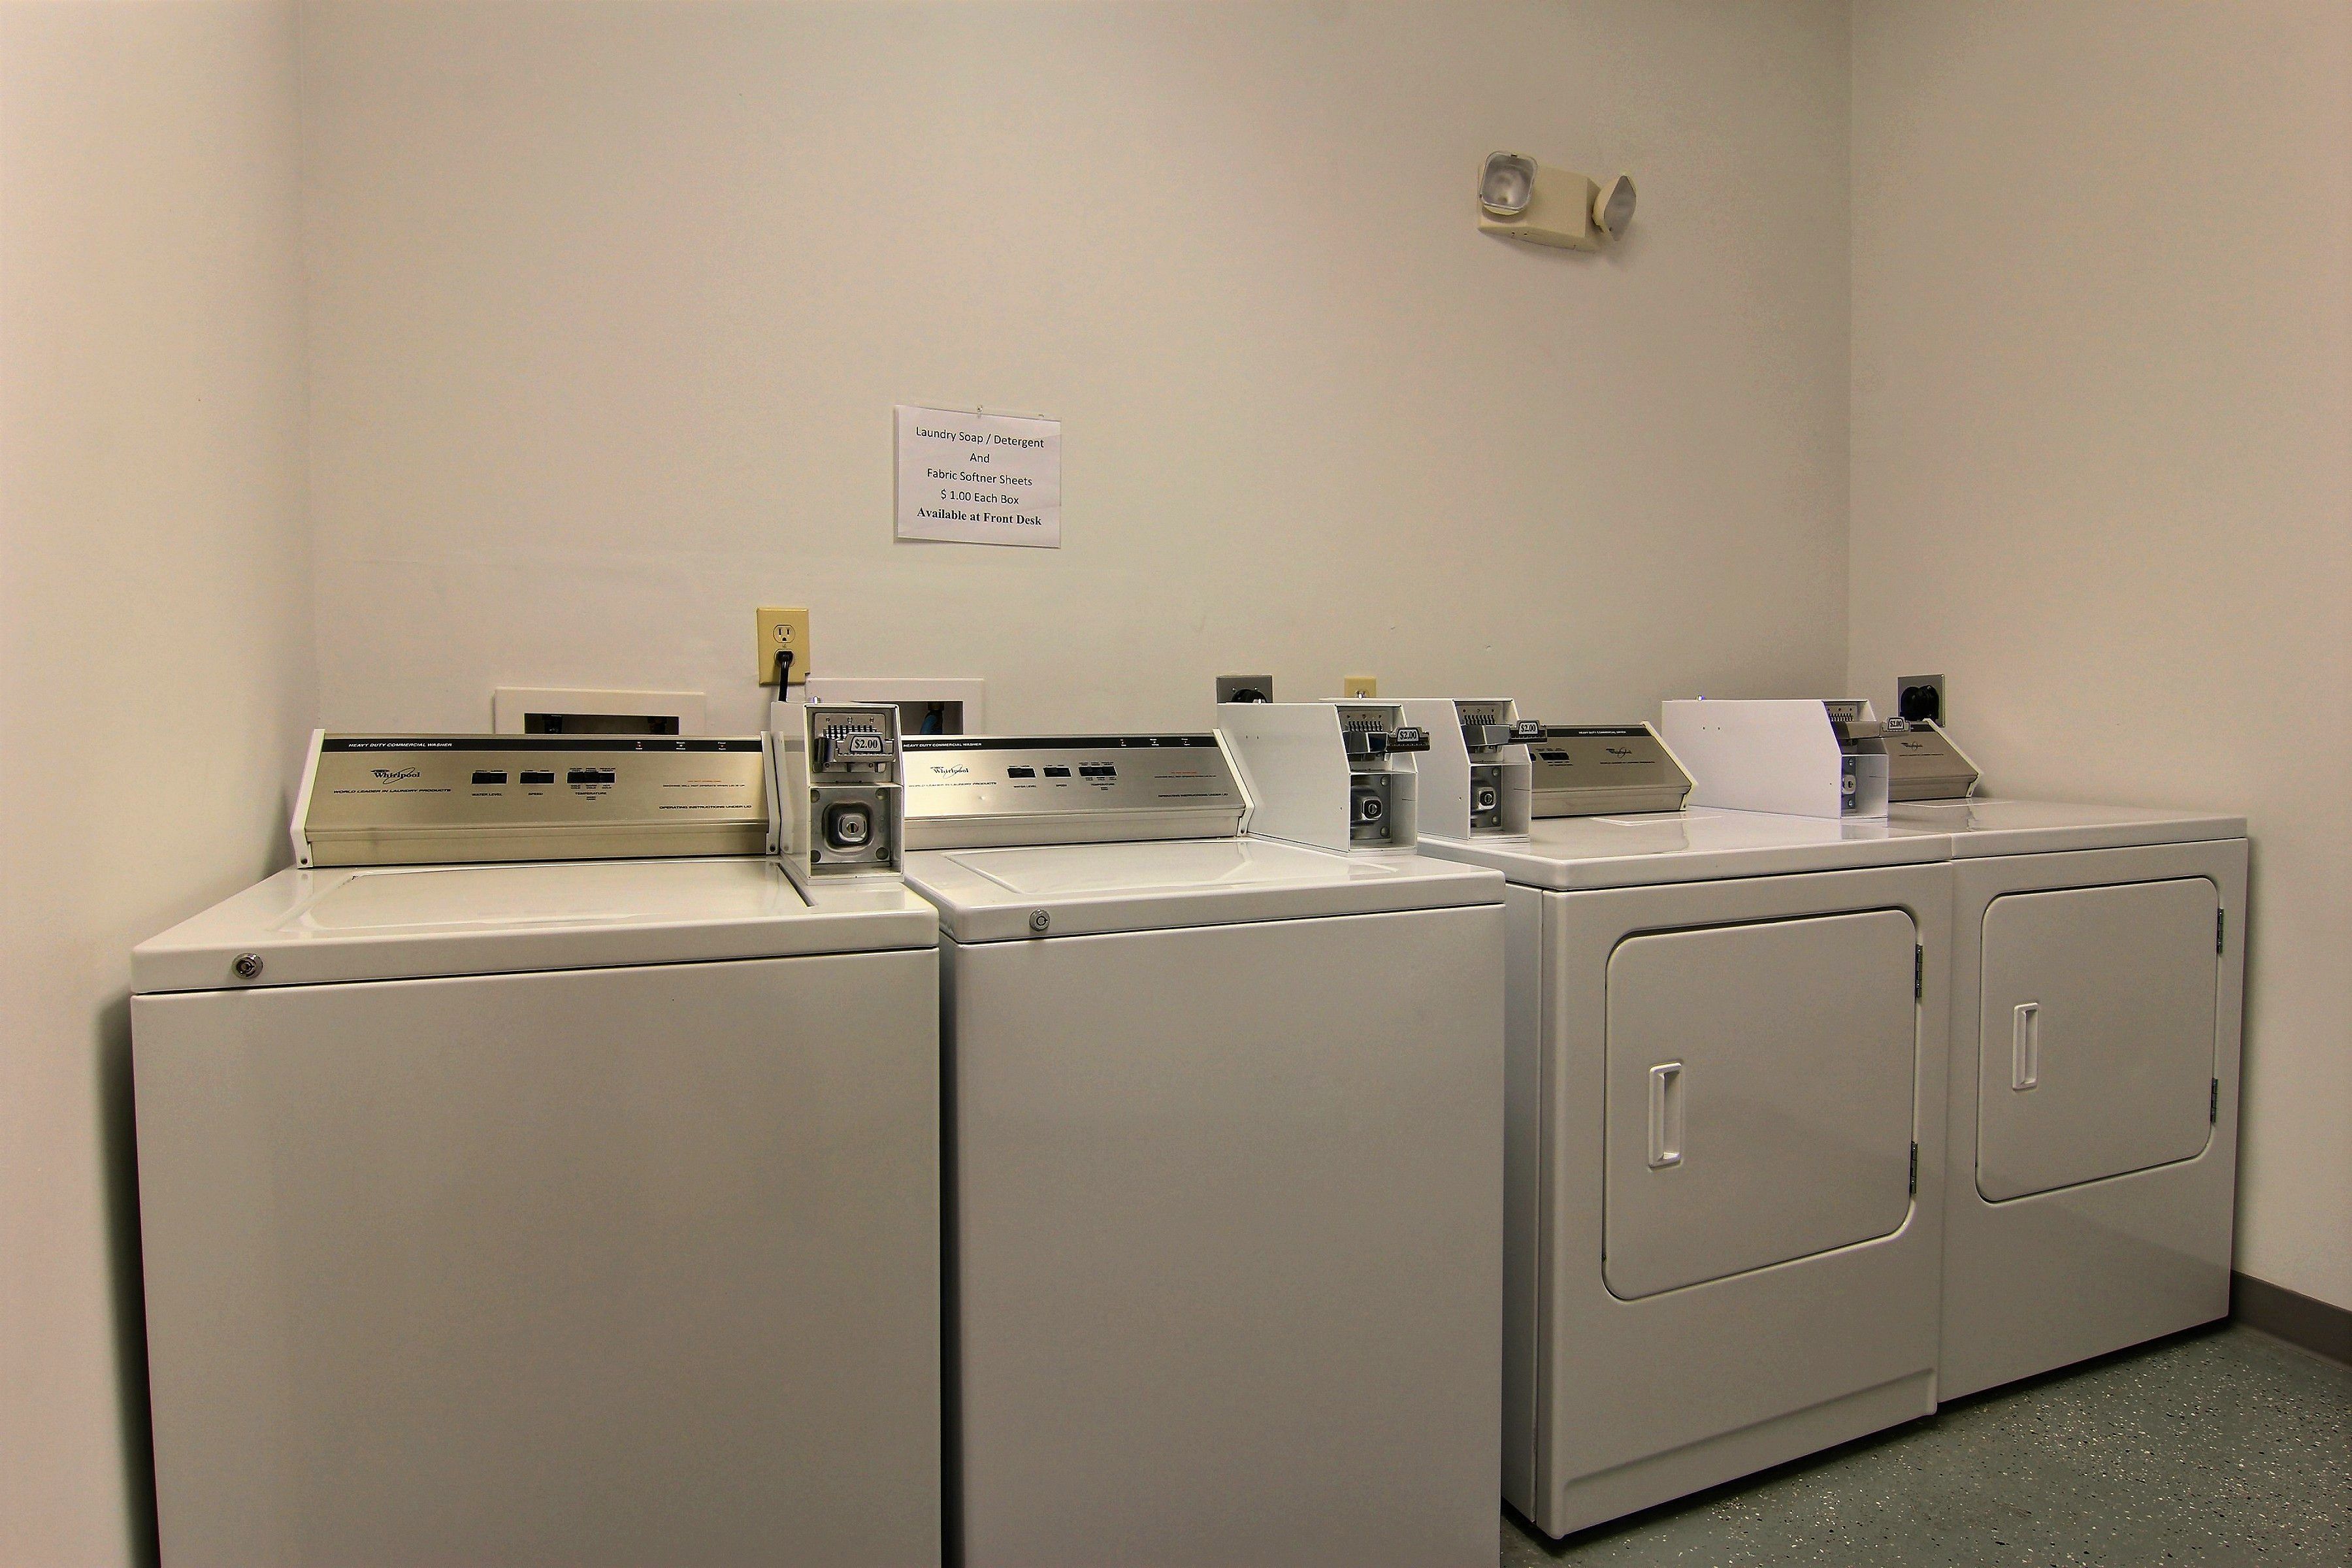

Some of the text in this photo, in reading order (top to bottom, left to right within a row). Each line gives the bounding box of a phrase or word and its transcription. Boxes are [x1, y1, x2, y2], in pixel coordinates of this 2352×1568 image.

[916, 427, 1045, 448] Laundry Soap / Detergent
[970, 453, 990, 463] And
[927, 468, 1032, 485] Fabric Softner Sheets
[941, 489, 1019, 504] $ 1.00 Each Box
[917, 508, 1041, 525] Available at Front Desk
[1520, 723, 1536, 732] $2.00
[1399, 731, 1417, 740] $2.00
[855, 739, 878, 749] $2.00
[373, 770, 420, 780] Whirlpool
